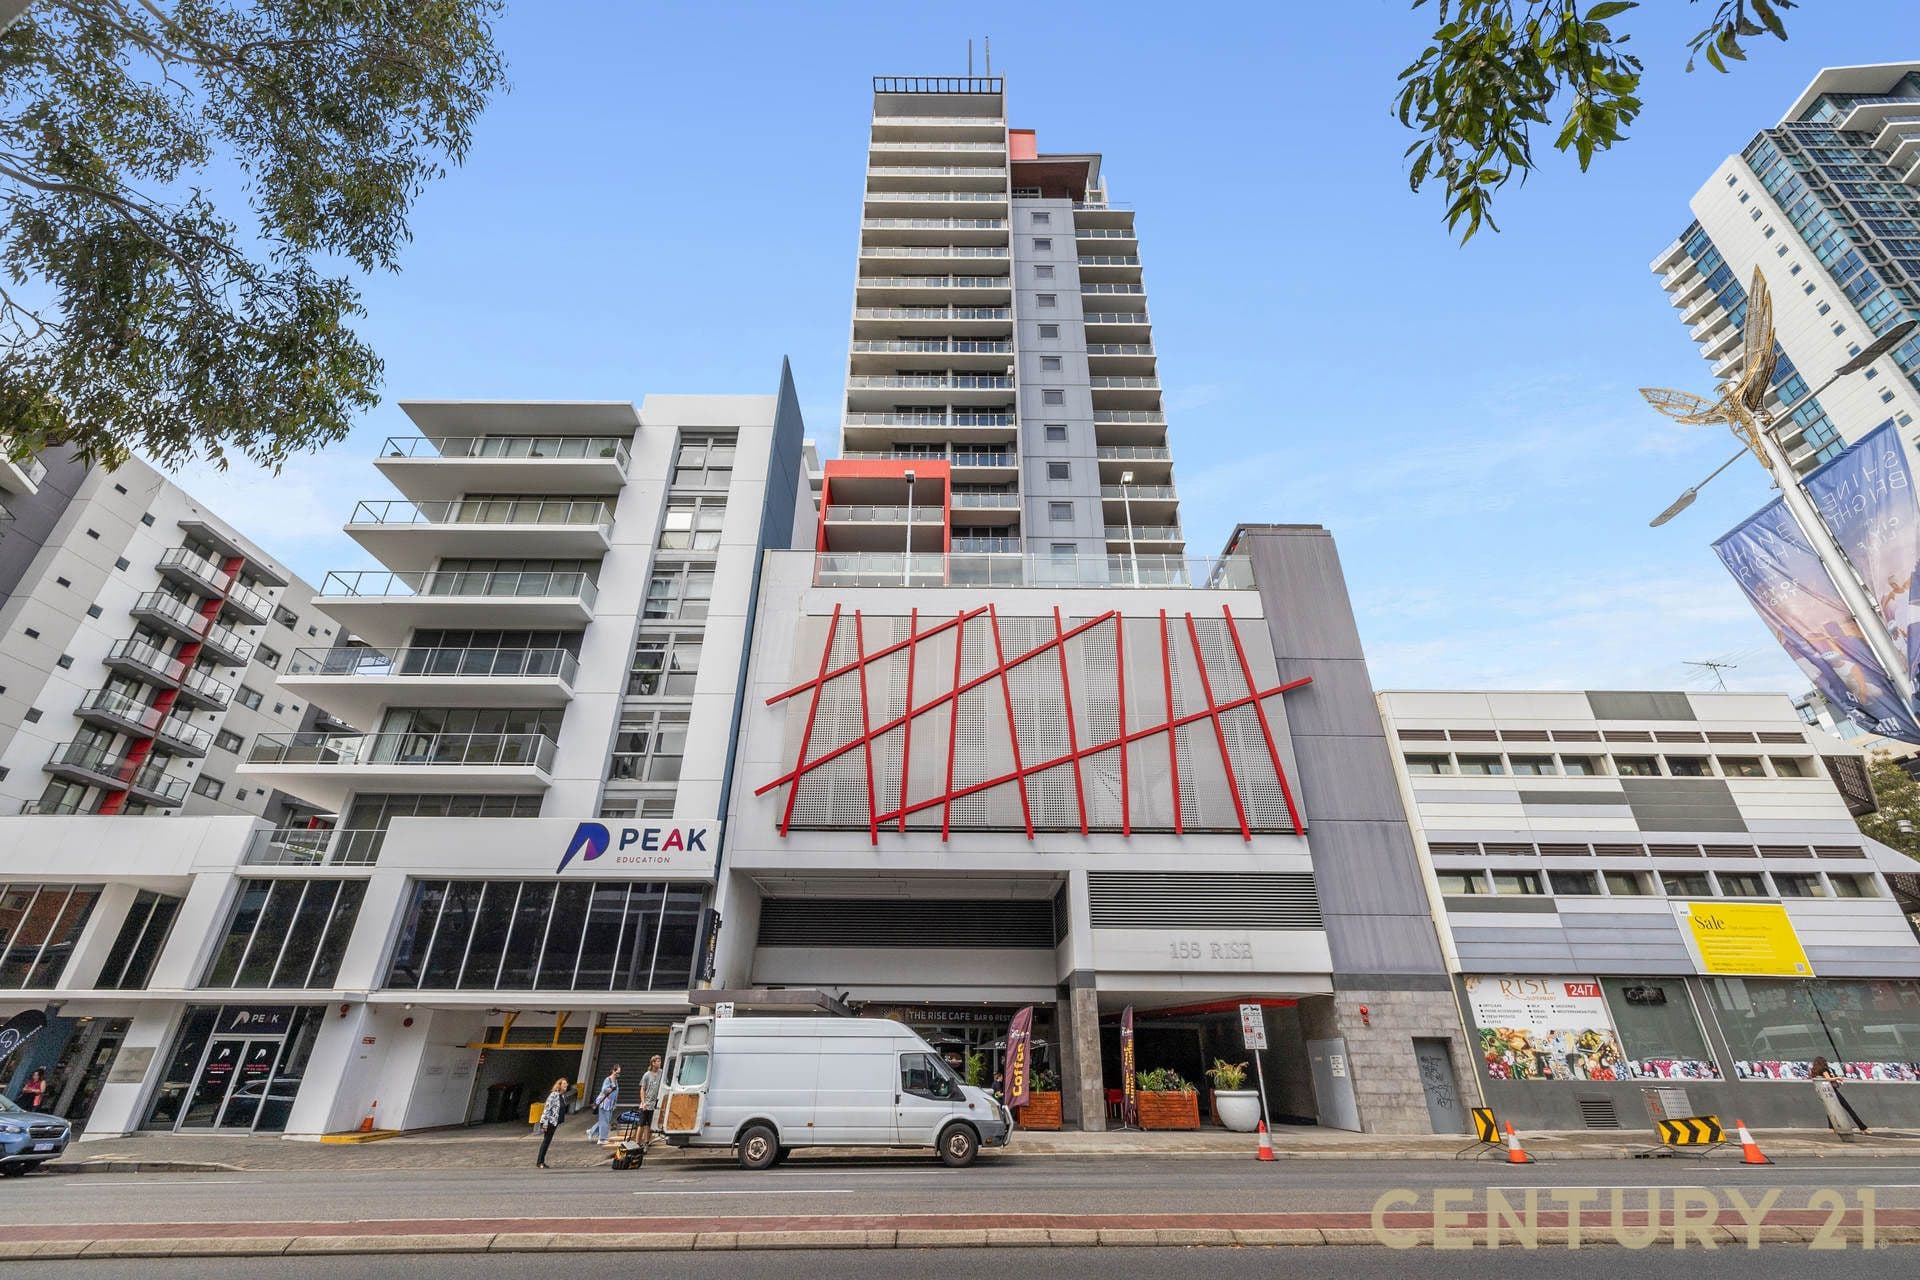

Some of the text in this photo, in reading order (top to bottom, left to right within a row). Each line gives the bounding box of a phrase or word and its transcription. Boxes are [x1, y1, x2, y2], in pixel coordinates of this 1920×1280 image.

[618, 828, 707, 852] PEAK
[616, 856, 671, 864] EDUCATION
[1694, 915, 1726, 931] Sale
[1209, 942, 1254, 960] RISE
[1499, 979, 1556, 1000] RISE
[1570, 984, 1595, 997] 24/7
[909, 1011, 927, 1021] THE
[927, 1011, 947, 1021] RISE
[948, 1012, 971, 1021] CAFE
